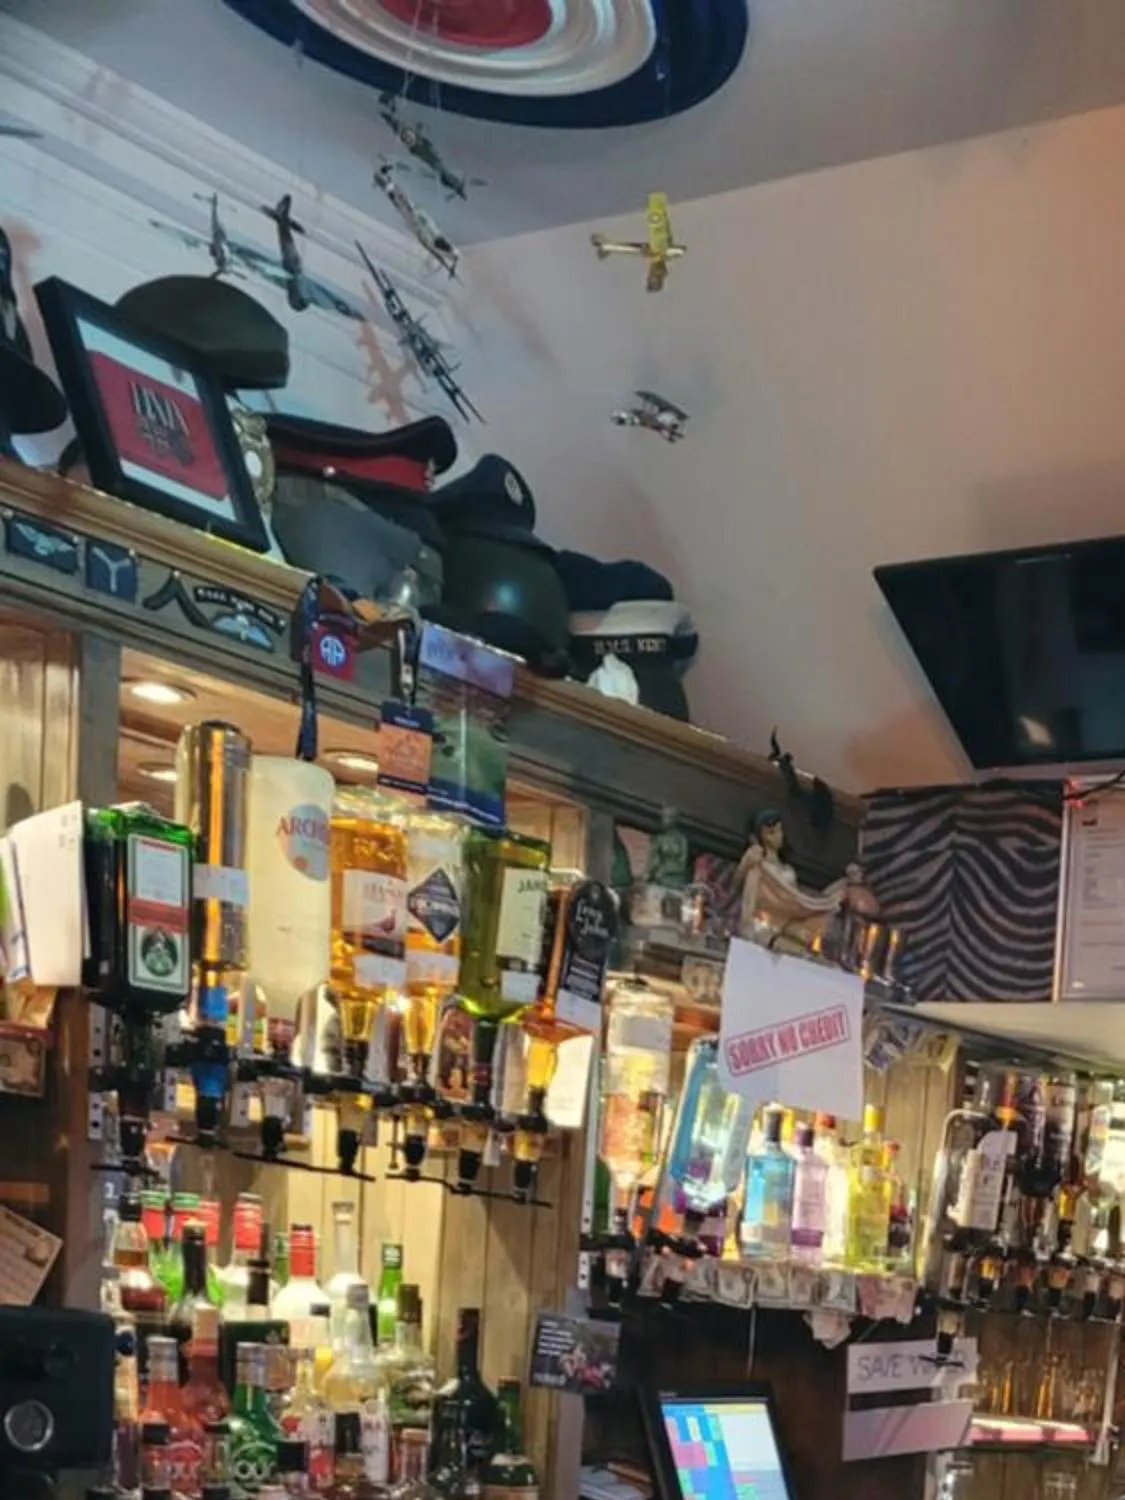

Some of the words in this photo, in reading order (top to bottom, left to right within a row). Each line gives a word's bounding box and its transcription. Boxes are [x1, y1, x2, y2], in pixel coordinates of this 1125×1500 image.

[729, 1032, 778, 1070] SORRY
[776, 1023, 799, 1054] NO
[798, 1010, 846, 1048] CREDIT
[856, 1353, 904, 1381] SAVE
